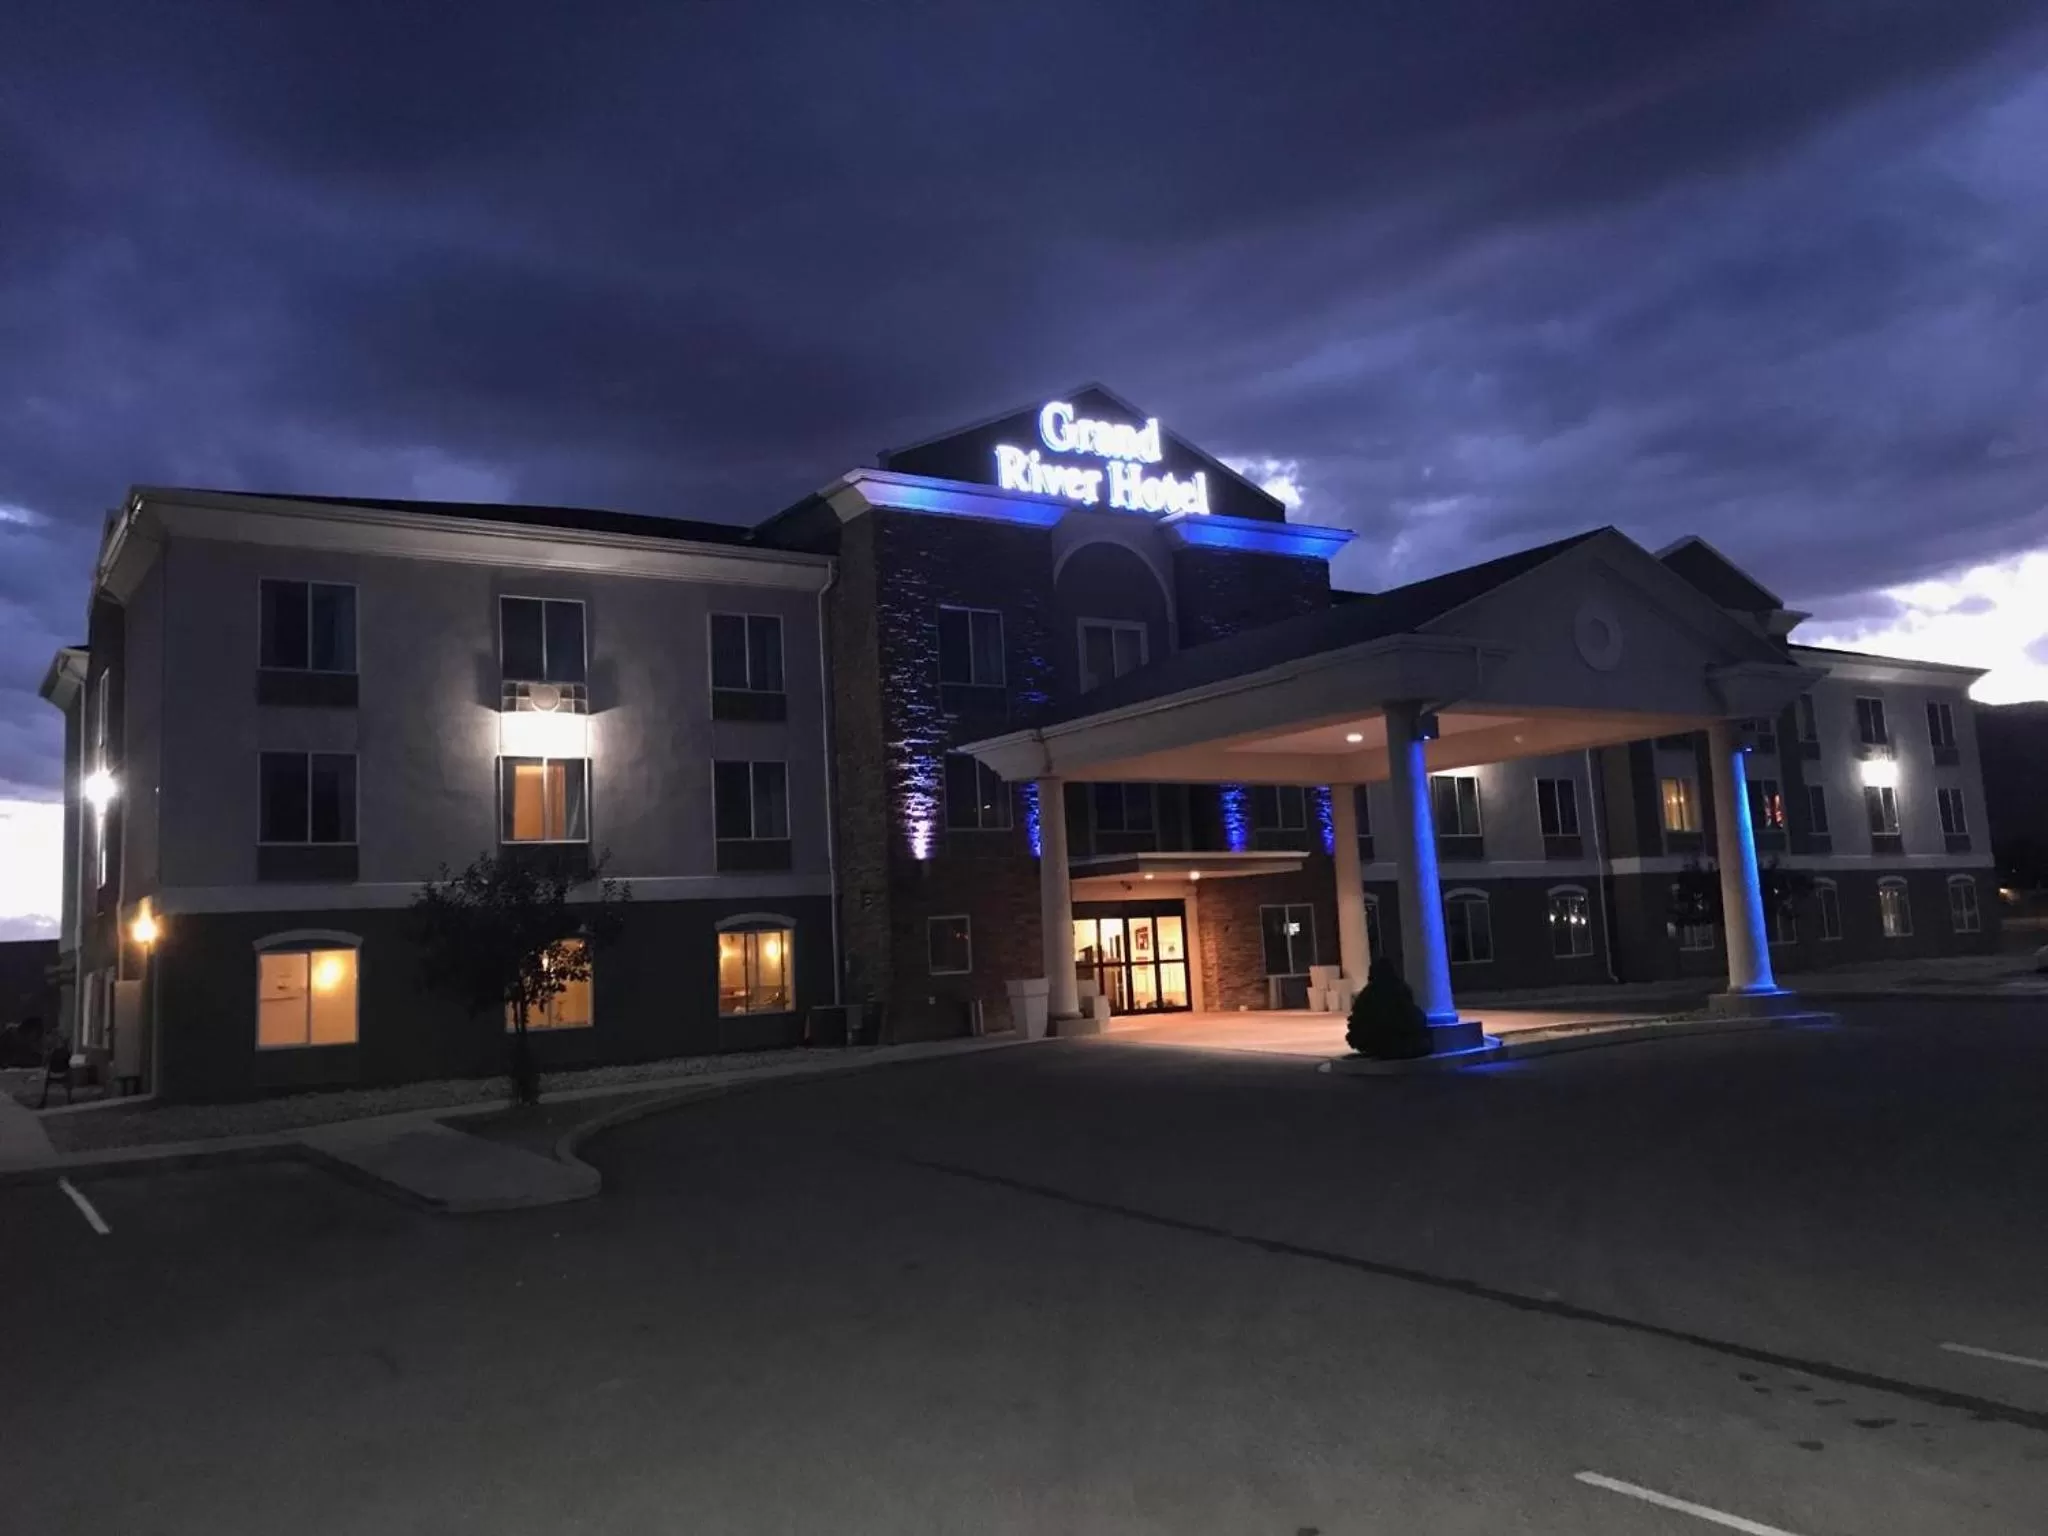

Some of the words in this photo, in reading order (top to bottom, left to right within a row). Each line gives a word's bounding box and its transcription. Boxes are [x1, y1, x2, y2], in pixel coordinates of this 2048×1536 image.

[1040, 401, 1162, 463] Grand
[995, 445, 1102, 504] River
[1108, 460, 1210, 515] Hotel
